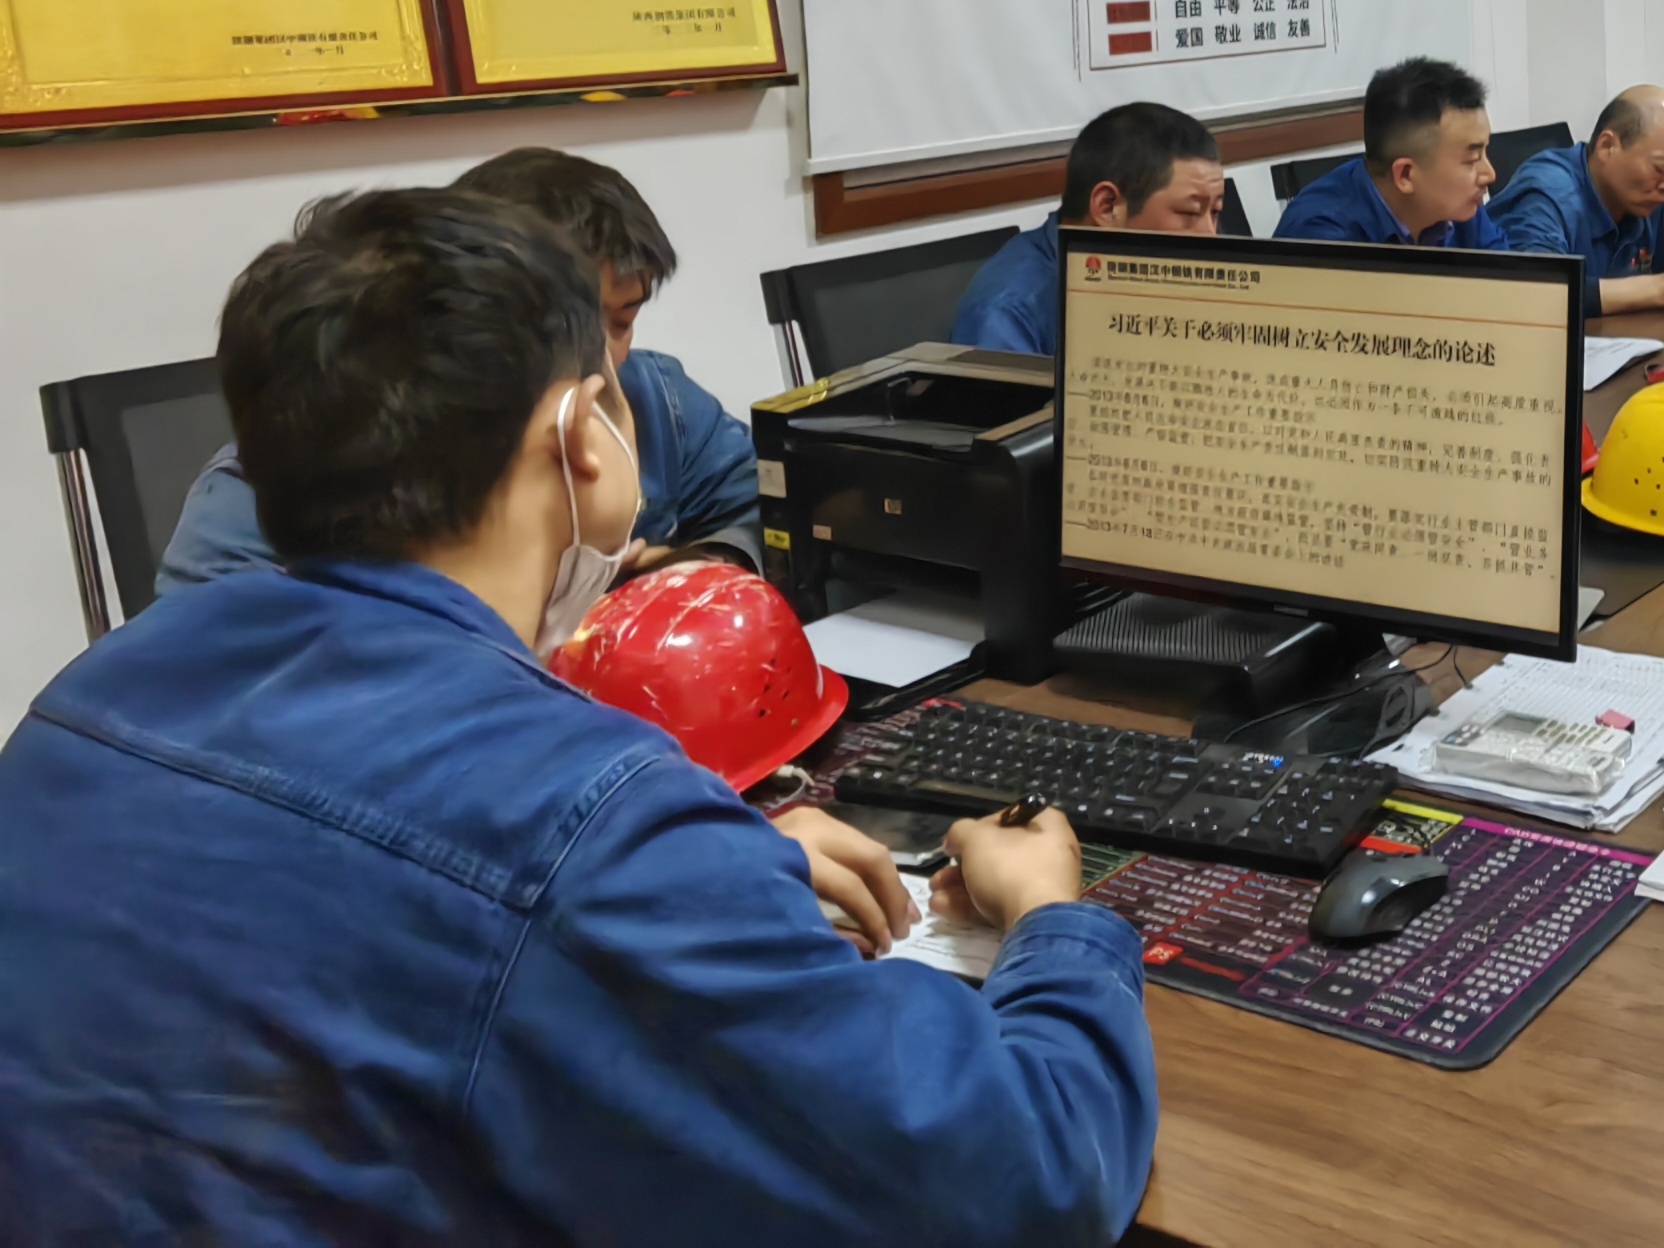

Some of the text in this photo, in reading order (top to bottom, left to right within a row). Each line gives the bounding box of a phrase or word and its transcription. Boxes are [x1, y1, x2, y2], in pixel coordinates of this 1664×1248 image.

[1175, 18, 1311, 49] 爱国 敬业 诚信 友善
[1108, 312, 1496, 367] 习近平关于必须牢固树立安全发展理念的论述
